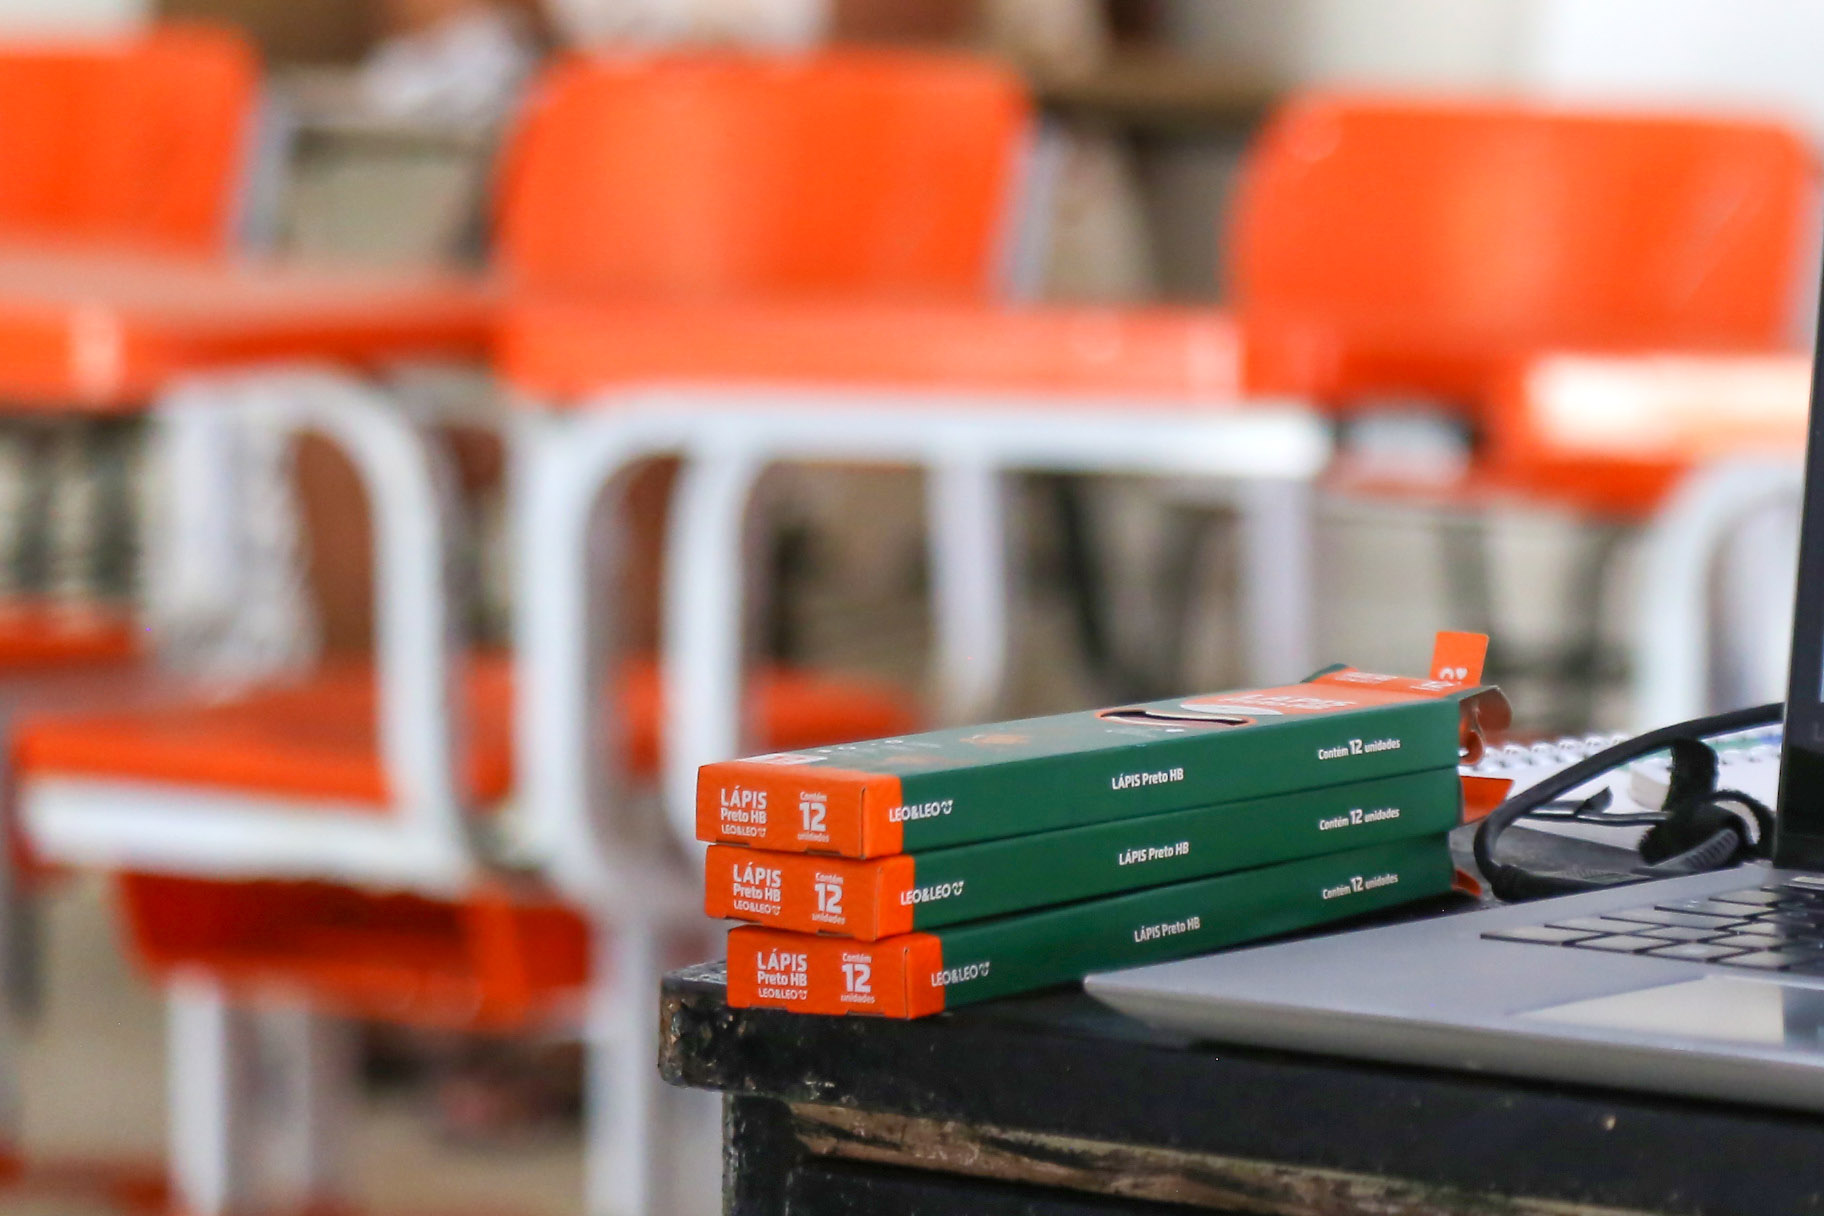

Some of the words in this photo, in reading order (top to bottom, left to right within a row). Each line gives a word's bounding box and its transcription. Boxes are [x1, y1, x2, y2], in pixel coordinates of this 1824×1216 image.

[1318, 746, 1348, 760] Contém
[1350, 739, 1362, 755] 12
[1365, 738, 1400, 752] unidades
[1112, 773, 1140, 790] LÁPIS
[1142, 770, 1168, 785] Preto
[1170, 768, 1184, 781] HB
[721, 785, 767, 809] LÁPIS
[721, 808, 749, 823] Preto
[751, 810, 767, 824] HB
[799, 802, 826, 832] 12
[889, 802, 940, 822] LEO&LEO
[1320, 817, 1349, 831] Contém
[1350, 809, 1363, 824] 12
[1365, 808, 1399, 822] unidades
[1119, 849, 1147, 865] LÁPIS
[1149, 844, 1174, 860] Preto
[1176, 841, 1189, 855] HB
[733, 861, 781, 886] LÁPIS
[733, 883, 762, 899] Preto
[765, 887, 781, 902] HB
[901, 884, 951, 905] LEO&LEO
[1323, 885, 1351, 899] Contém
[1351, 876, 1363, 892] 12
[1366, 873, 1398, 888] unidades
[815, 884, 842, 914] 12
[1134, 925, 1160, 942] LÁPIS
[1162, 921, 1185, 936] Preto
[1187, 917, 1200, 930] HB
[757, 948, 807, 971] LÁPIS
[757, 970, 788, 985] Preto
[790, 972, 807, 986] HB
[842, 963, 871, 993] 12
[931, 966, 978, 987] LEO&LEO
